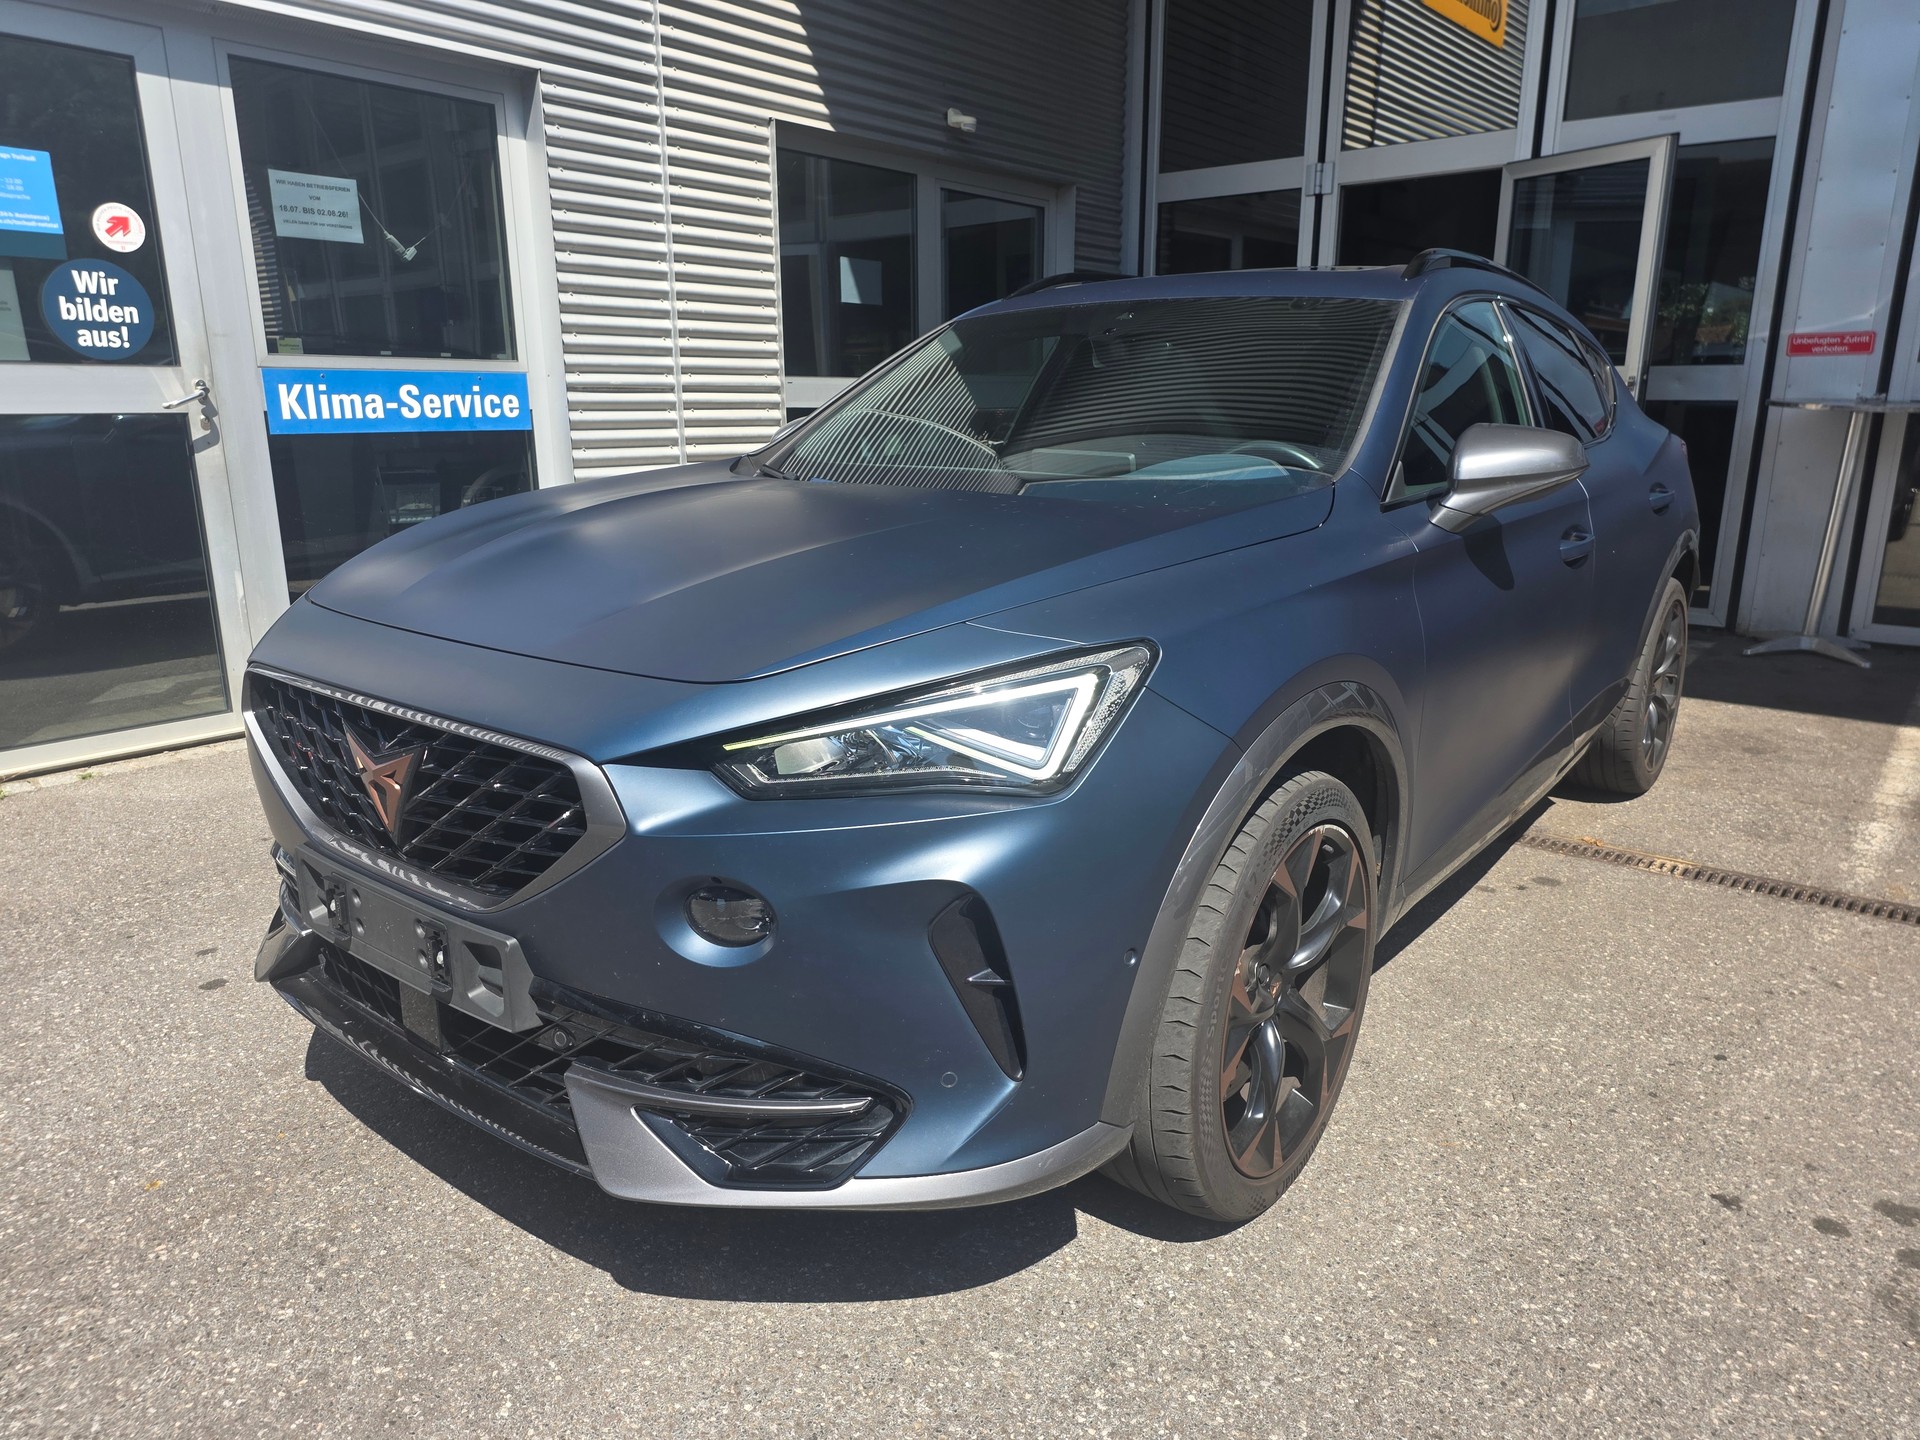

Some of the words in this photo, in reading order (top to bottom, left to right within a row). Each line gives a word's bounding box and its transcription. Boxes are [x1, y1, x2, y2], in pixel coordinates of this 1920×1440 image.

[302, 207, 315, 215] BIS
[71, 269, 119, 296] Wir
[58, 295, 140, 324] bilden
[77, 326, 131, 349] aus!
[1792, 335, 1840, 345] Unbefugten
[1843, 335, 1870, 344] Zutritt
[1811, 345, 1848, 353] verboten
[277, 382, 520, 420] Klima-Service
